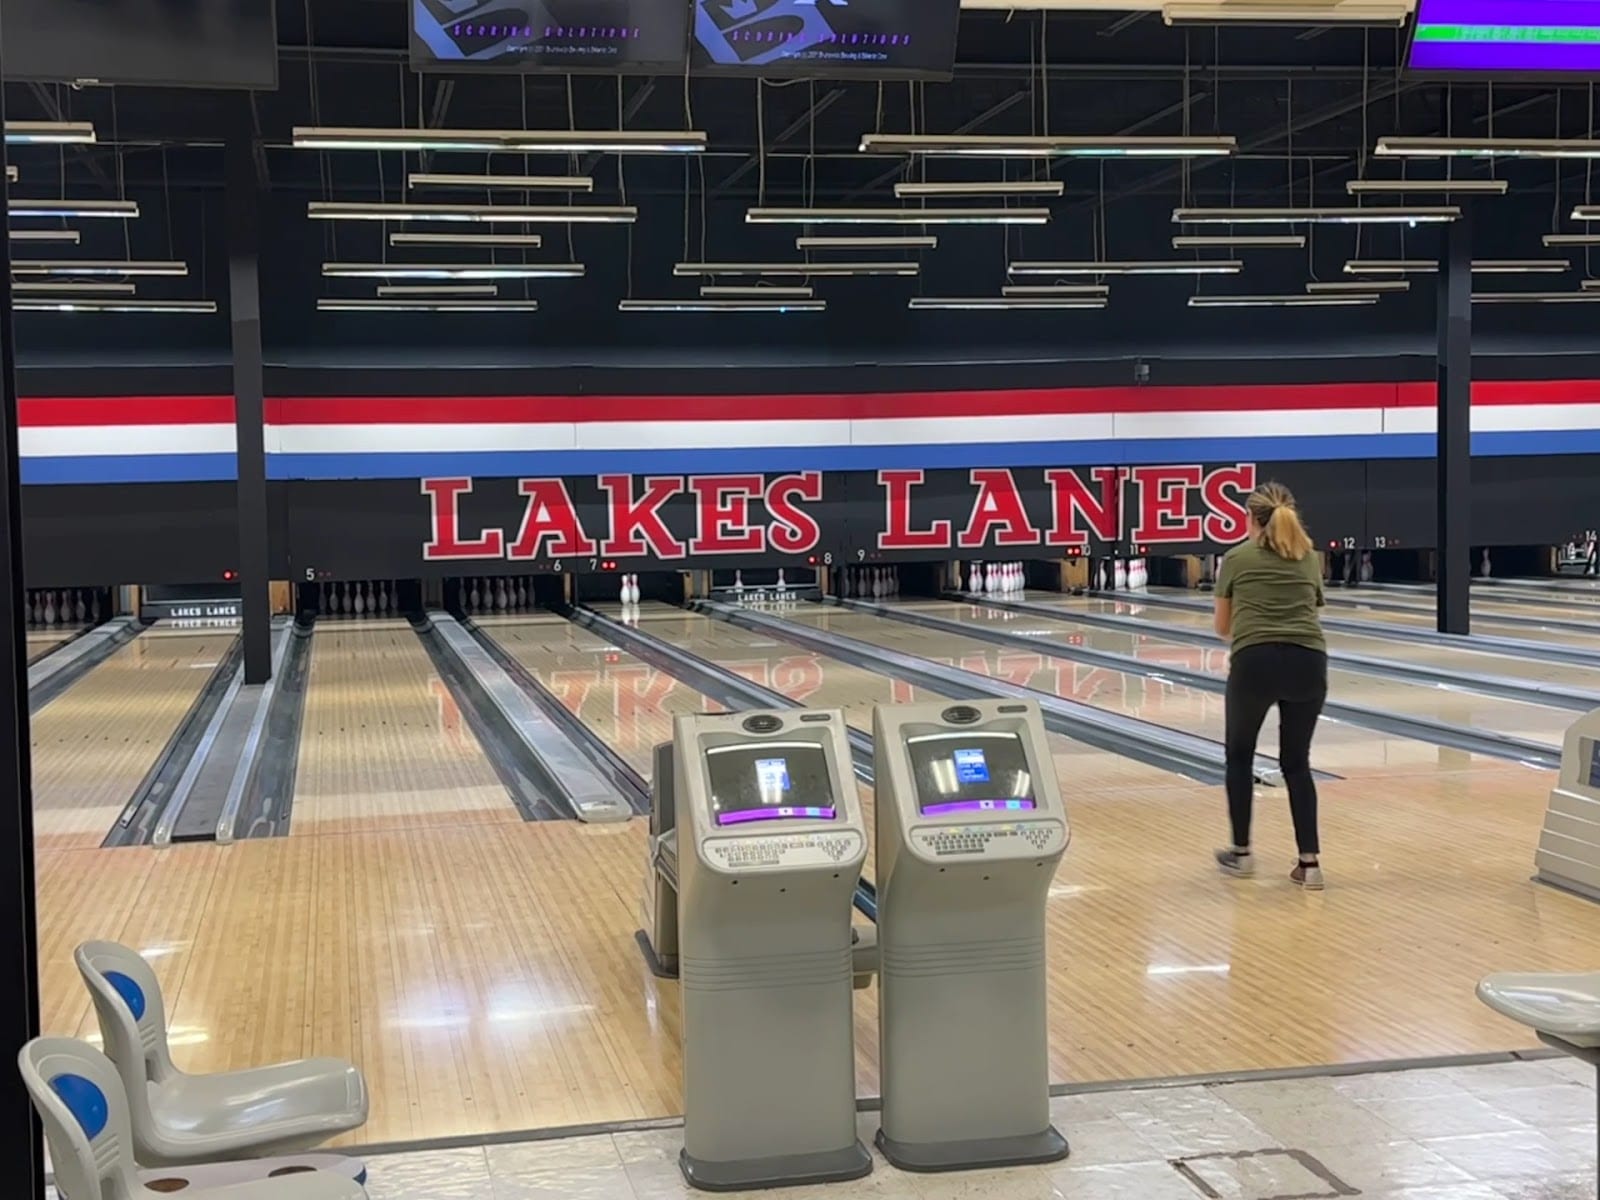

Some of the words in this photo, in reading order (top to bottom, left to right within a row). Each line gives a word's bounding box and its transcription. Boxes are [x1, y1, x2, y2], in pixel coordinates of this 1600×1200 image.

[421, 471, 823, 561] LAKES
[877, 463, 1257, 549] LANES
[1343, 536, 1356, 549] 12
[1375, 536, 1386, 549] 13
[857, 549, 866, 561] 9
[1081, 544, 1092, 556] 10
[1130, 544, 1139, 556] 11
[589, 558, 597, 570] 7
[824, 552, 832, 564] 8
[553, 559, 562, 571] 6
[306, 568, 315, 581] 5
